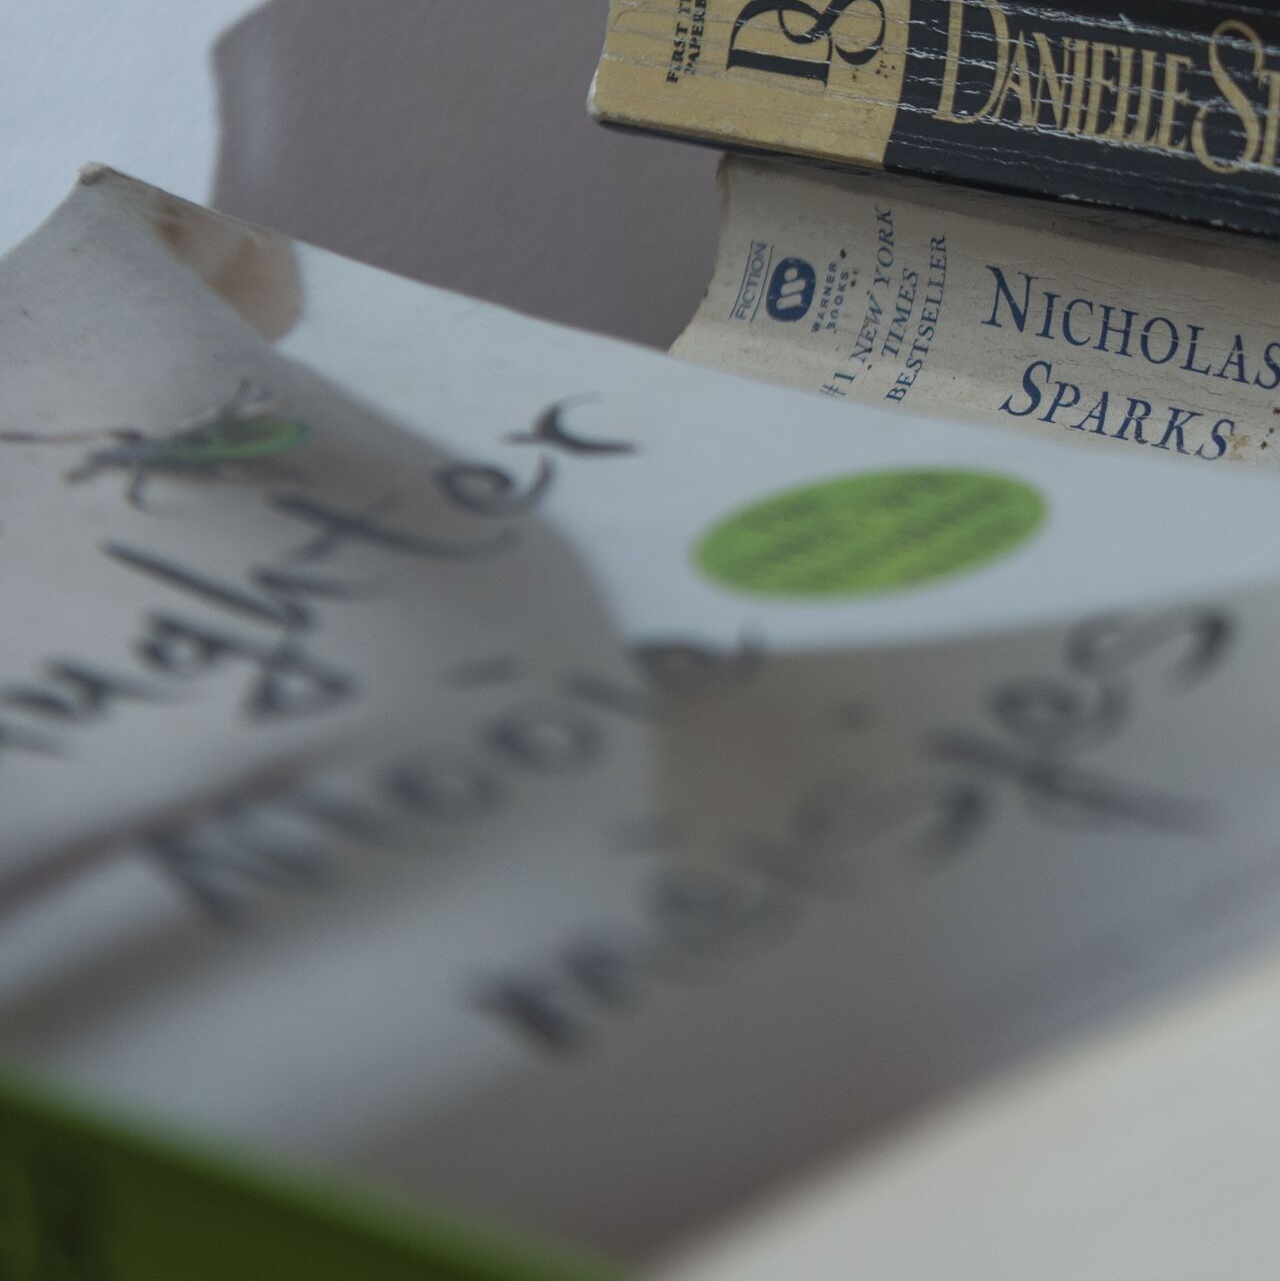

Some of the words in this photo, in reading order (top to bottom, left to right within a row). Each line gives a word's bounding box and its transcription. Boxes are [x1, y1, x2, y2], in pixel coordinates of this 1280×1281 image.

[666, 22, 688, 84] FIRST
[735, 241, 767, 320] FICTION
[811, 261, 837, 333] WARNER
[820, 372, 857, 399] #1
[849, 293, 883, 366] NEW
[873, 204, 895, 287] YORK
[881, 268, 919, 359] TIMES
[884, 233, 947, 404] BESTSELLER
[998, 360, 1236, 461] SPARKS
